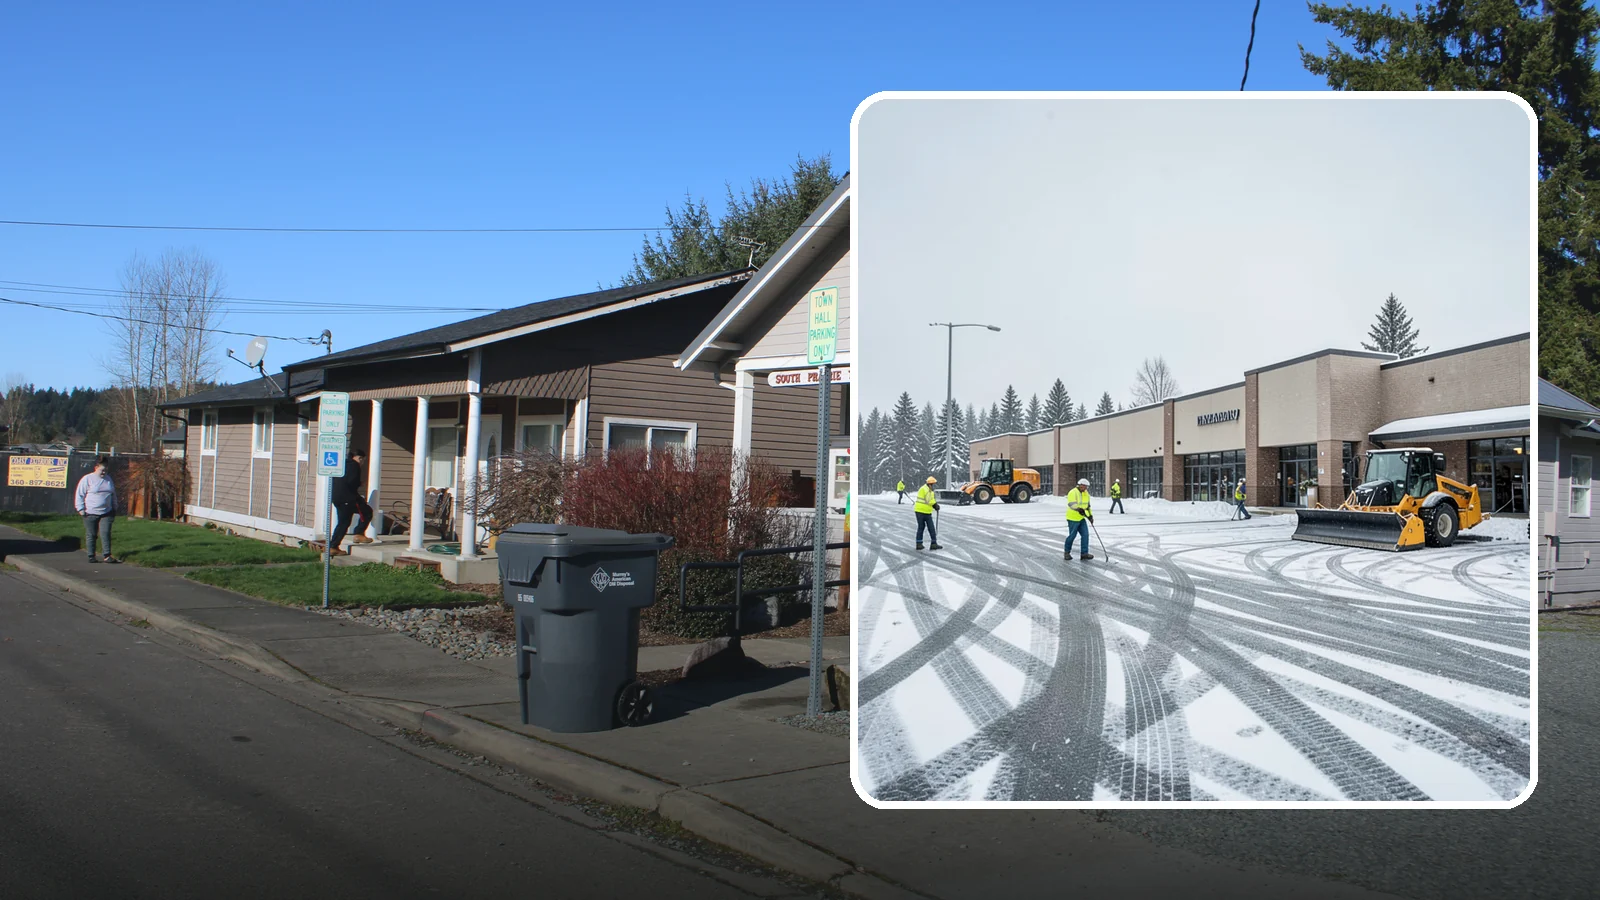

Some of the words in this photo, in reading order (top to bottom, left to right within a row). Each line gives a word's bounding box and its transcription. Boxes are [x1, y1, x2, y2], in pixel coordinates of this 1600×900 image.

[815, 294, 833, 307] TOWN
[814, 311, 831, 324] HALL
[810, 327, 836, 340] PARKING
[813, 344, 831, 357] ONLY
[775, 373, 801, 384] SOUTH
[325, 420, 340, 428] ONLY
